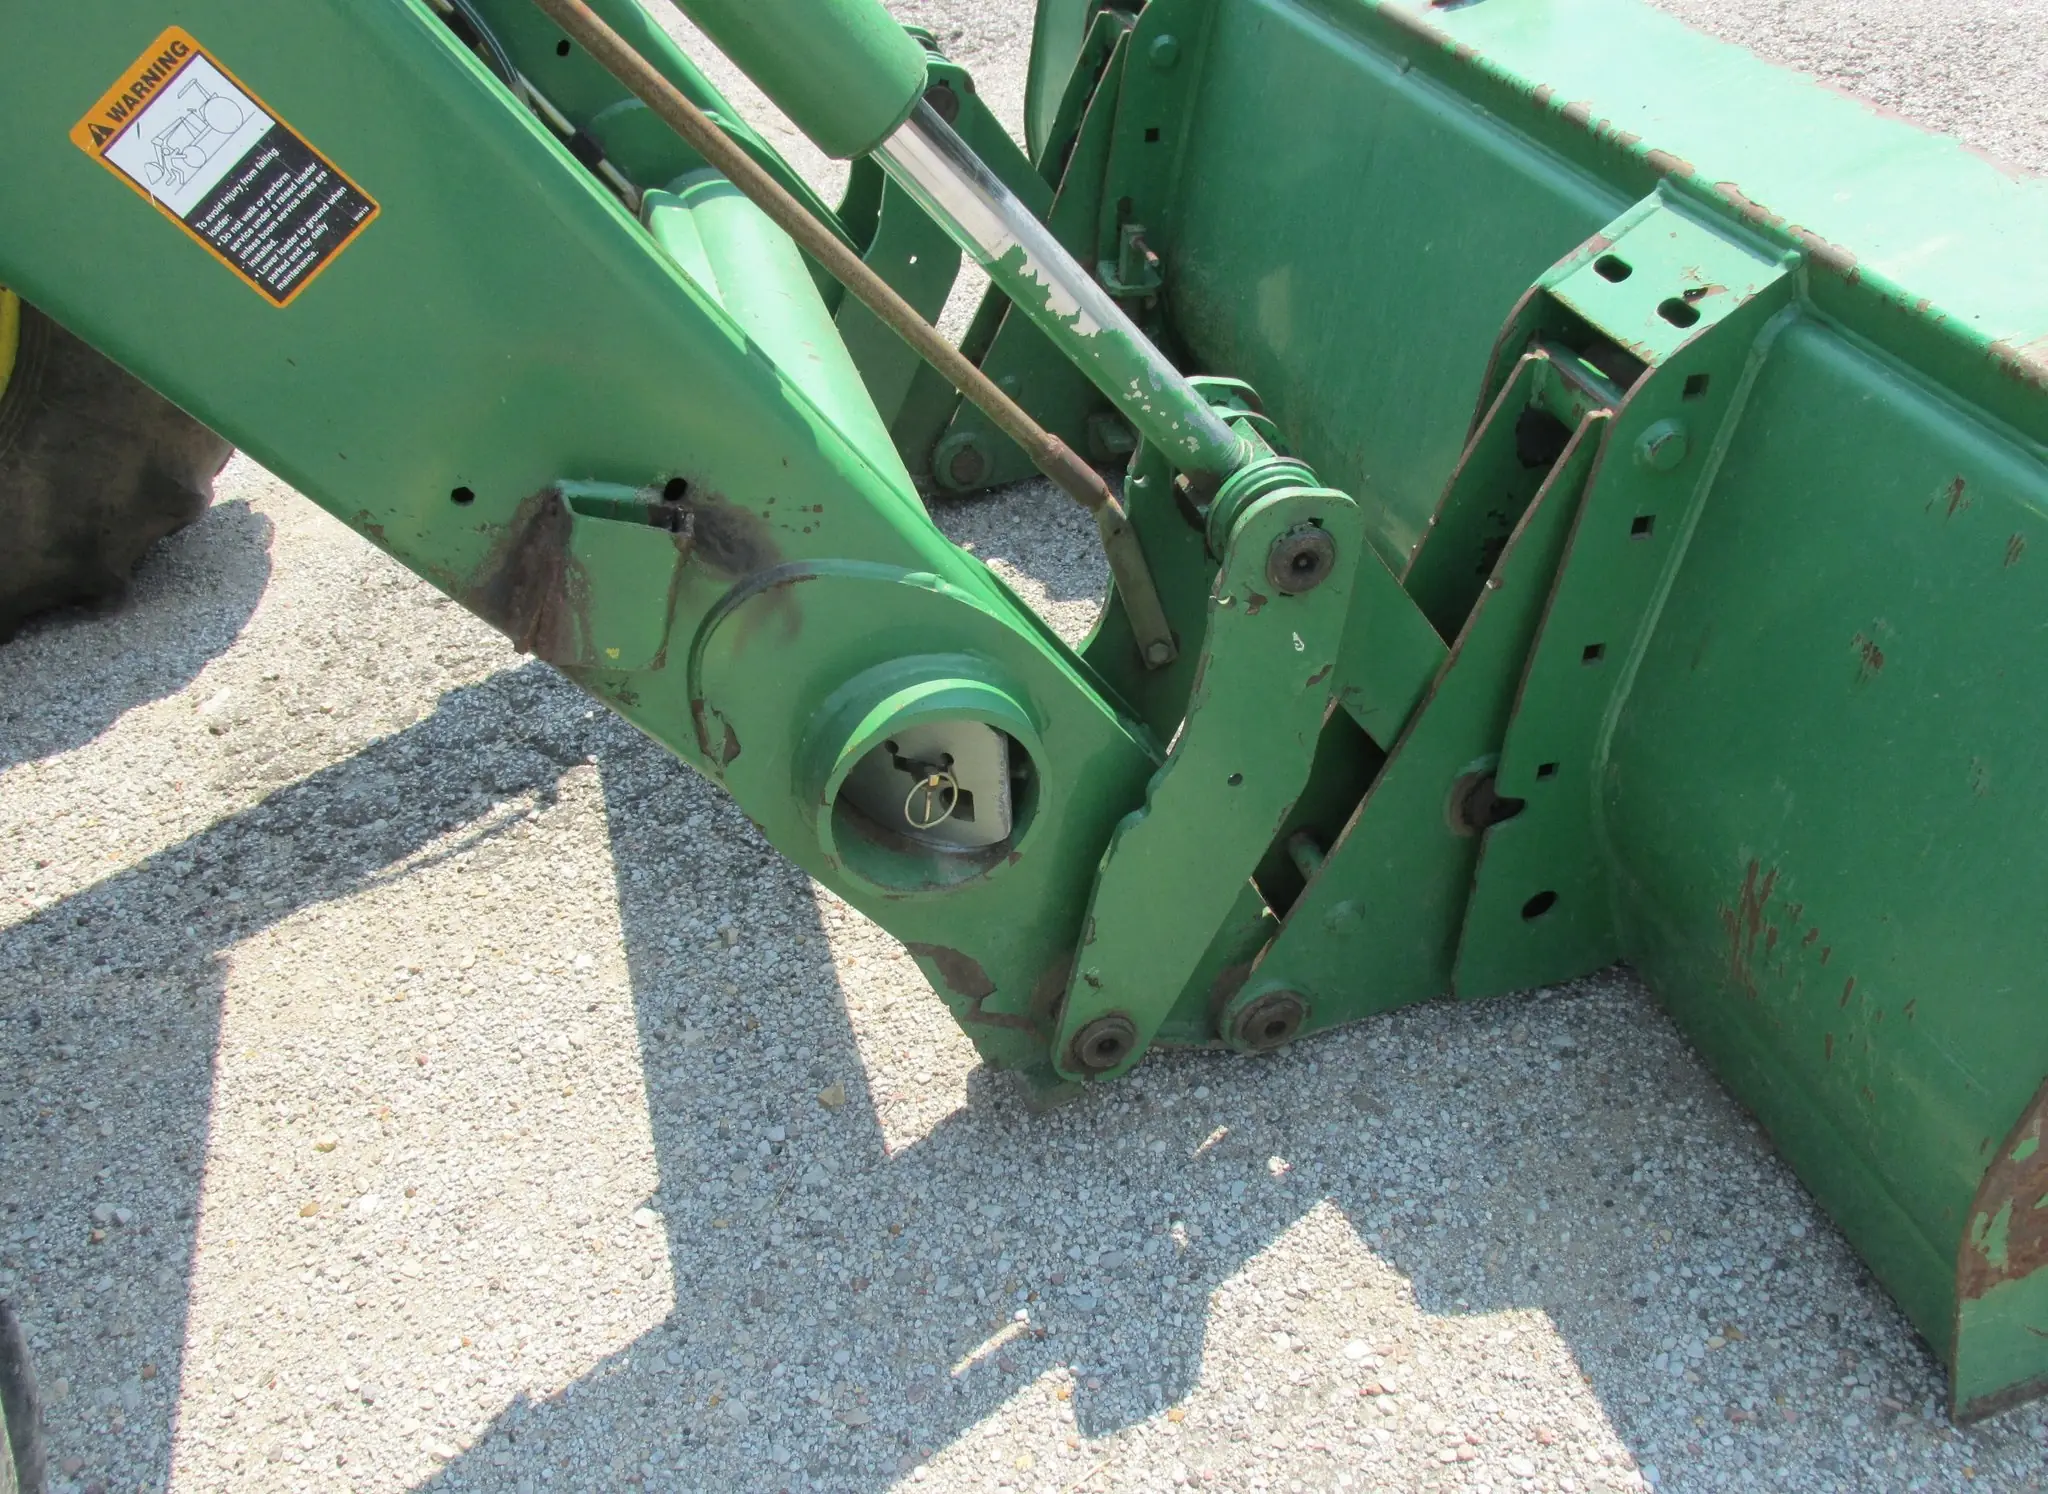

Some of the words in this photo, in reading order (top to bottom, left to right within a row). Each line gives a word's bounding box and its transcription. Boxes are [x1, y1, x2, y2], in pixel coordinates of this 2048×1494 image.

[106, 40, 190, 123] WARNING
[195, 220, 207, 231] To
[205, 201, 224, 222] avoid
[221, 183, 244, 205] injury
[239, 168, 258, 186] from
[255, 147, 280, 171] falling
[207, 213, 232, 237] loader:
[219, 232, 232, 243] Do
[229, 219, 243, 233] not
[240, 205, 258, 222] walk
[256, 196, 265, 207] or
[263, 172, 291, 200] perform
[229, 227, 254, 252] service
[251, 207, 272, 229] under
[275, 182, 297, 205] raised
[294, 162, 317, 184] loader
[239, 238, 261, 260] unless
[258, 220, 279, 239] boom
[276, 197, 300, 222] service
[297, 181, 317, 199] locks
[315, 170, 327, 183] are
[247, 238, 278, 267] installed.
[257, 253, 279, 275] Lower
[276, 233, 299, 255] loader
[296, 226, 306, 235] to
[305, 202, 330, 229] ground
[327, 186, 347, 205] when
[267, 259, 291, 284] parked
[288, 247, 303, 261] and
[300, 237, 312, 249] for
[310, 221, 329, 240] daily
[276, 247, 318, 290] maintenance.
